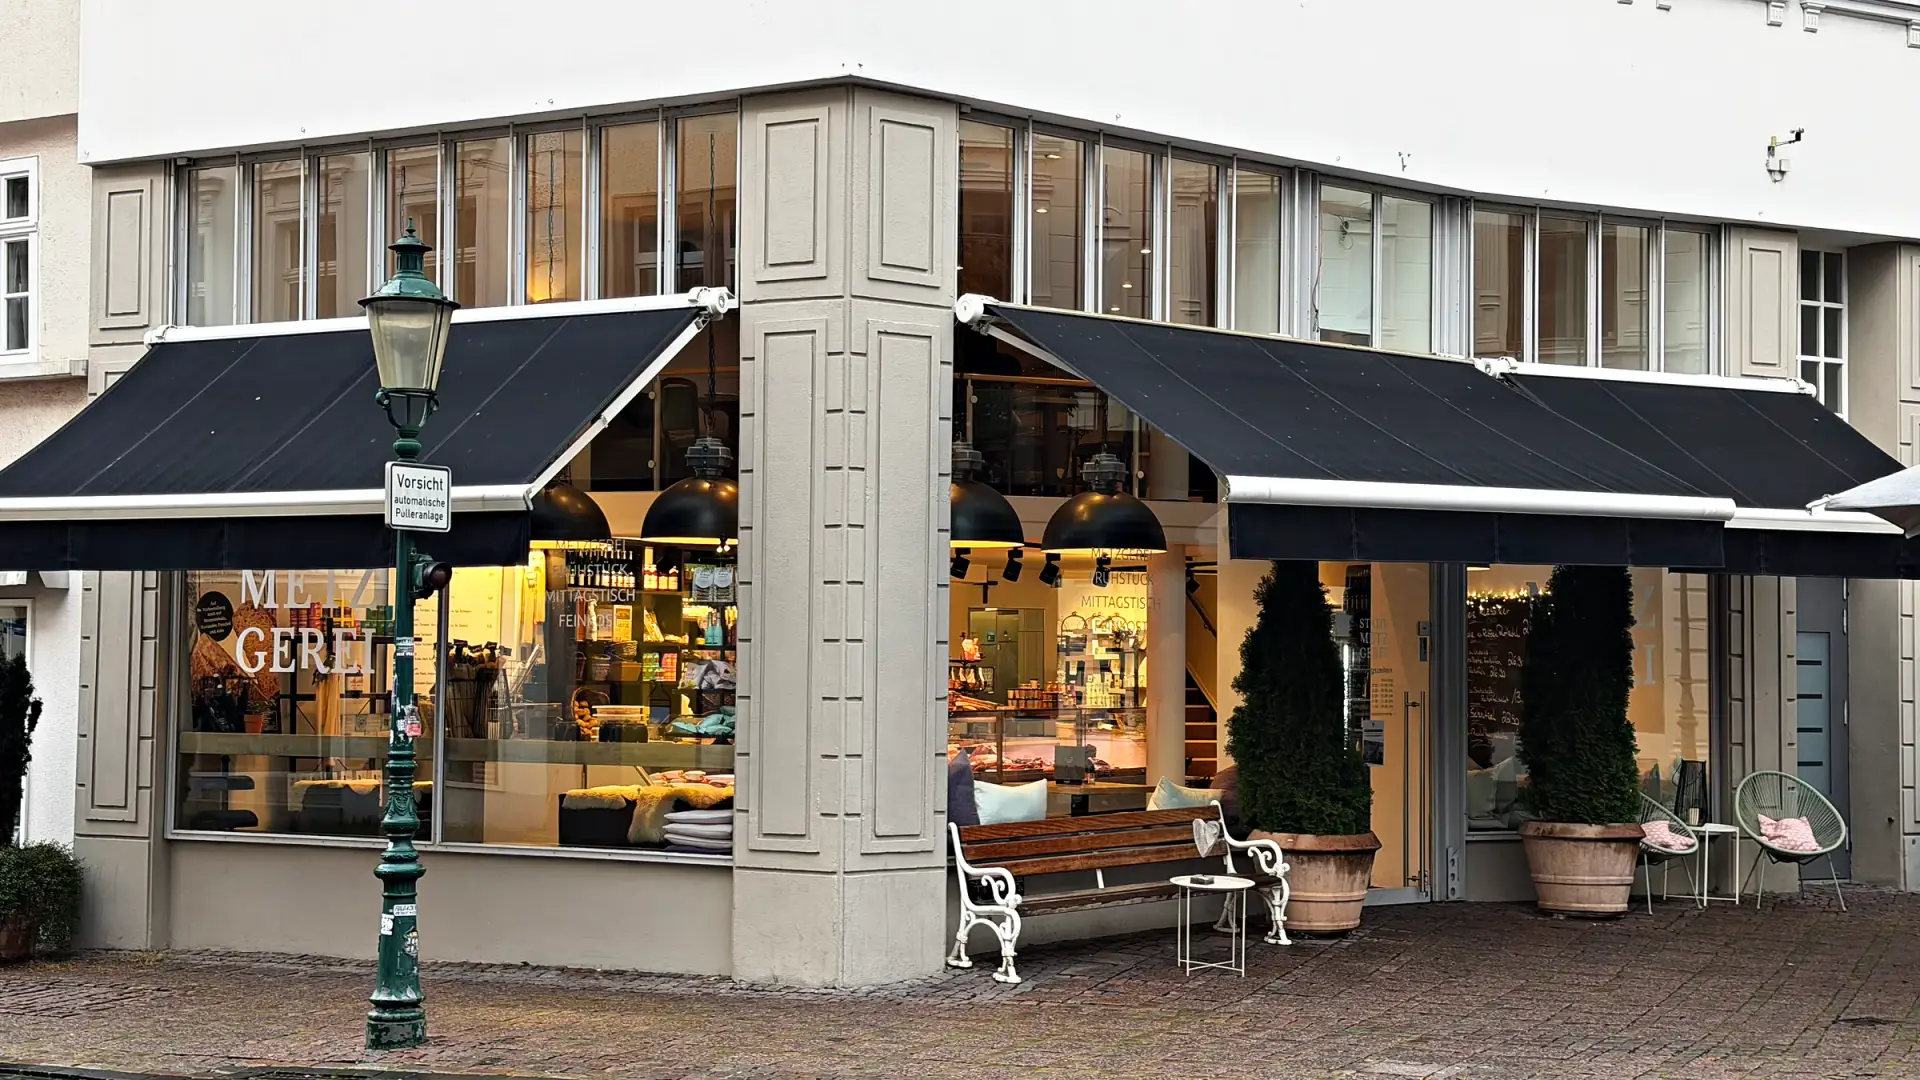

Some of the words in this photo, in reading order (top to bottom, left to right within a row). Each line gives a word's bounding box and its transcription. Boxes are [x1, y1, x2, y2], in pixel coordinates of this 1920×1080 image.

[397, 473, 444, 491] Vorsicht
[394, 496, 446, 508] automatische
[241, 569, 377, 609] METZ
[545, 588, 636, 603] MITTAGSTISCH
[1081, 596, 1161, 611] MITTAGSTISCH
[235, 627, 376, 675] GEREI
